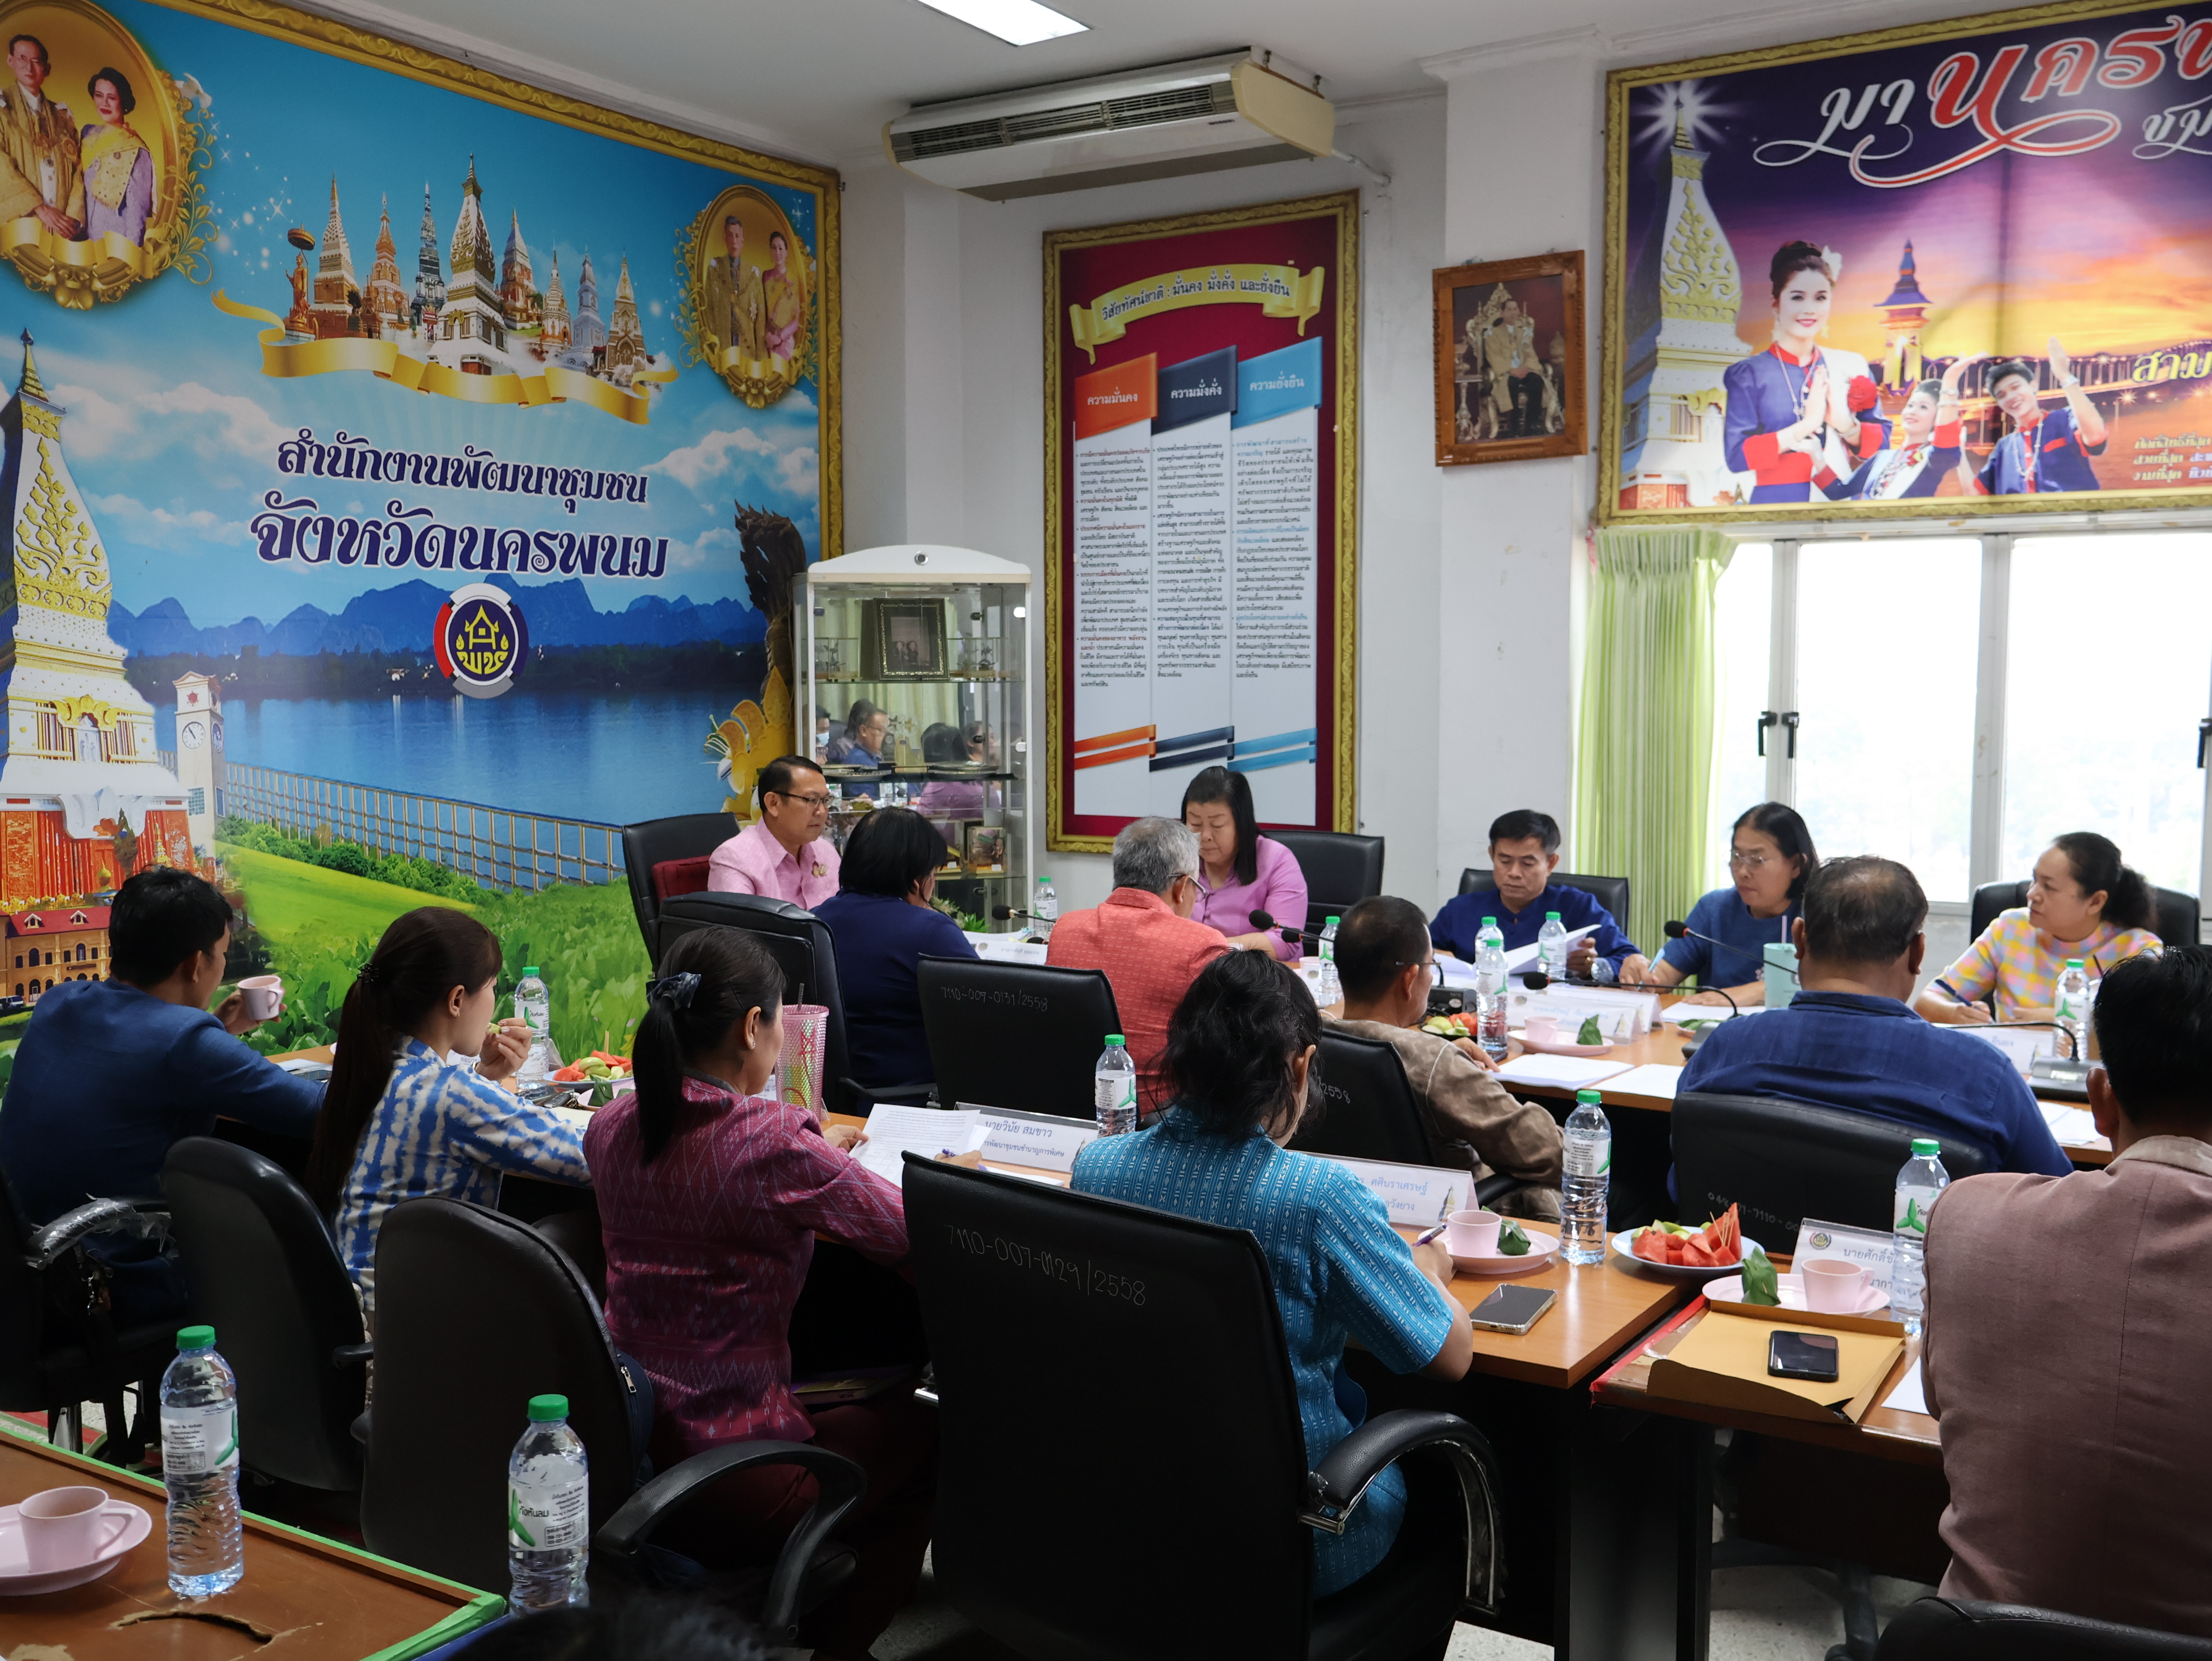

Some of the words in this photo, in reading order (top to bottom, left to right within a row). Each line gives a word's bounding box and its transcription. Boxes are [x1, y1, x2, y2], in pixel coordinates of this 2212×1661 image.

[1102, 284, 1164, 321] วิสัยทัศน์ชาติ
[1173, 271, 1203, 297] มั่นคง
[1207, 269, 1235, 292] มั่งคั่ง
[1240, 271, 1291, 297] และยั่งยืน
[1171, 377, 1222, 399] ความมั่งคั่ง
[1249, 370, 1305, 392] ความยั่งยืน
[1087, 383, 1138, 405] ความมั่นคง
[278, 428, 648, 514] สำนักงานพัฒนาชุมชน
[250, 490, 670, 578] จังหวัดนครพนม
[941, 986, 1048, 1012] 7110-007-0131/2558
[985, 1120, 1020, 1133] นายวินัย
[1022, 1126, 1052, 1138] สมขาว
[984, 1139, 1064, 1157] ารพัฒนาชุมชนชำนาญการพิเศษ
[1385, 1198, 1414, 1210] อวังยาง
[1844, 1248, 1895, 1264] นายศักดิ์ชั
[519, 1506, 549, 1517] กังหันลม
